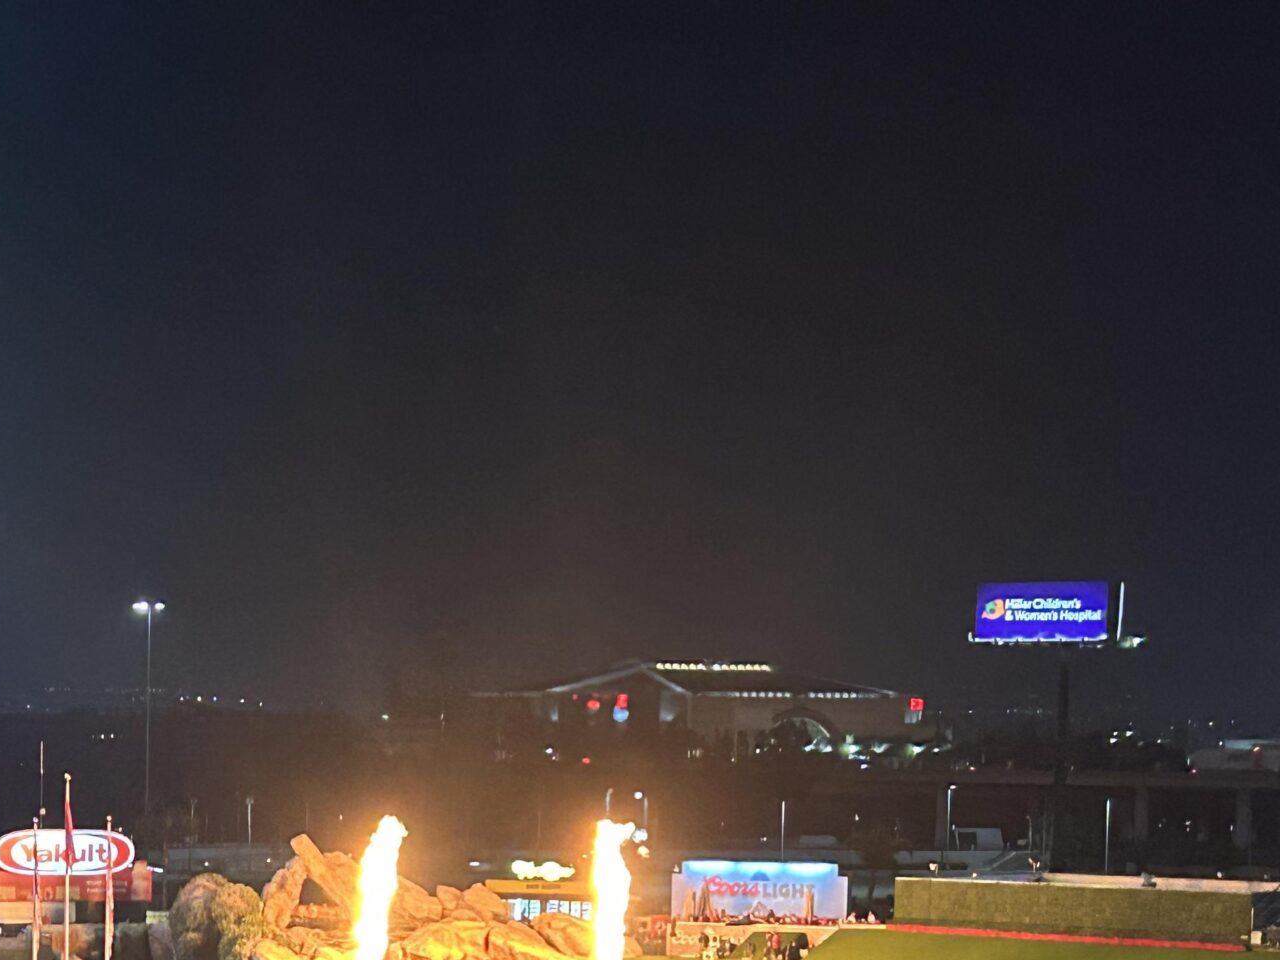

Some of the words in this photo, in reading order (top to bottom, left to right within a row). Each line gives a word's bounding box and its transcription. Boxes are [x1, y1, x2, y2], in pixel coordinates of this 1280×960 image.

[1033, 598, 1082, 609] Children's
[1014, 610, 1058, 621] Women's
[1060, 609, 1101, 622] Hospital
[704, 876, 760, 897] Coors
